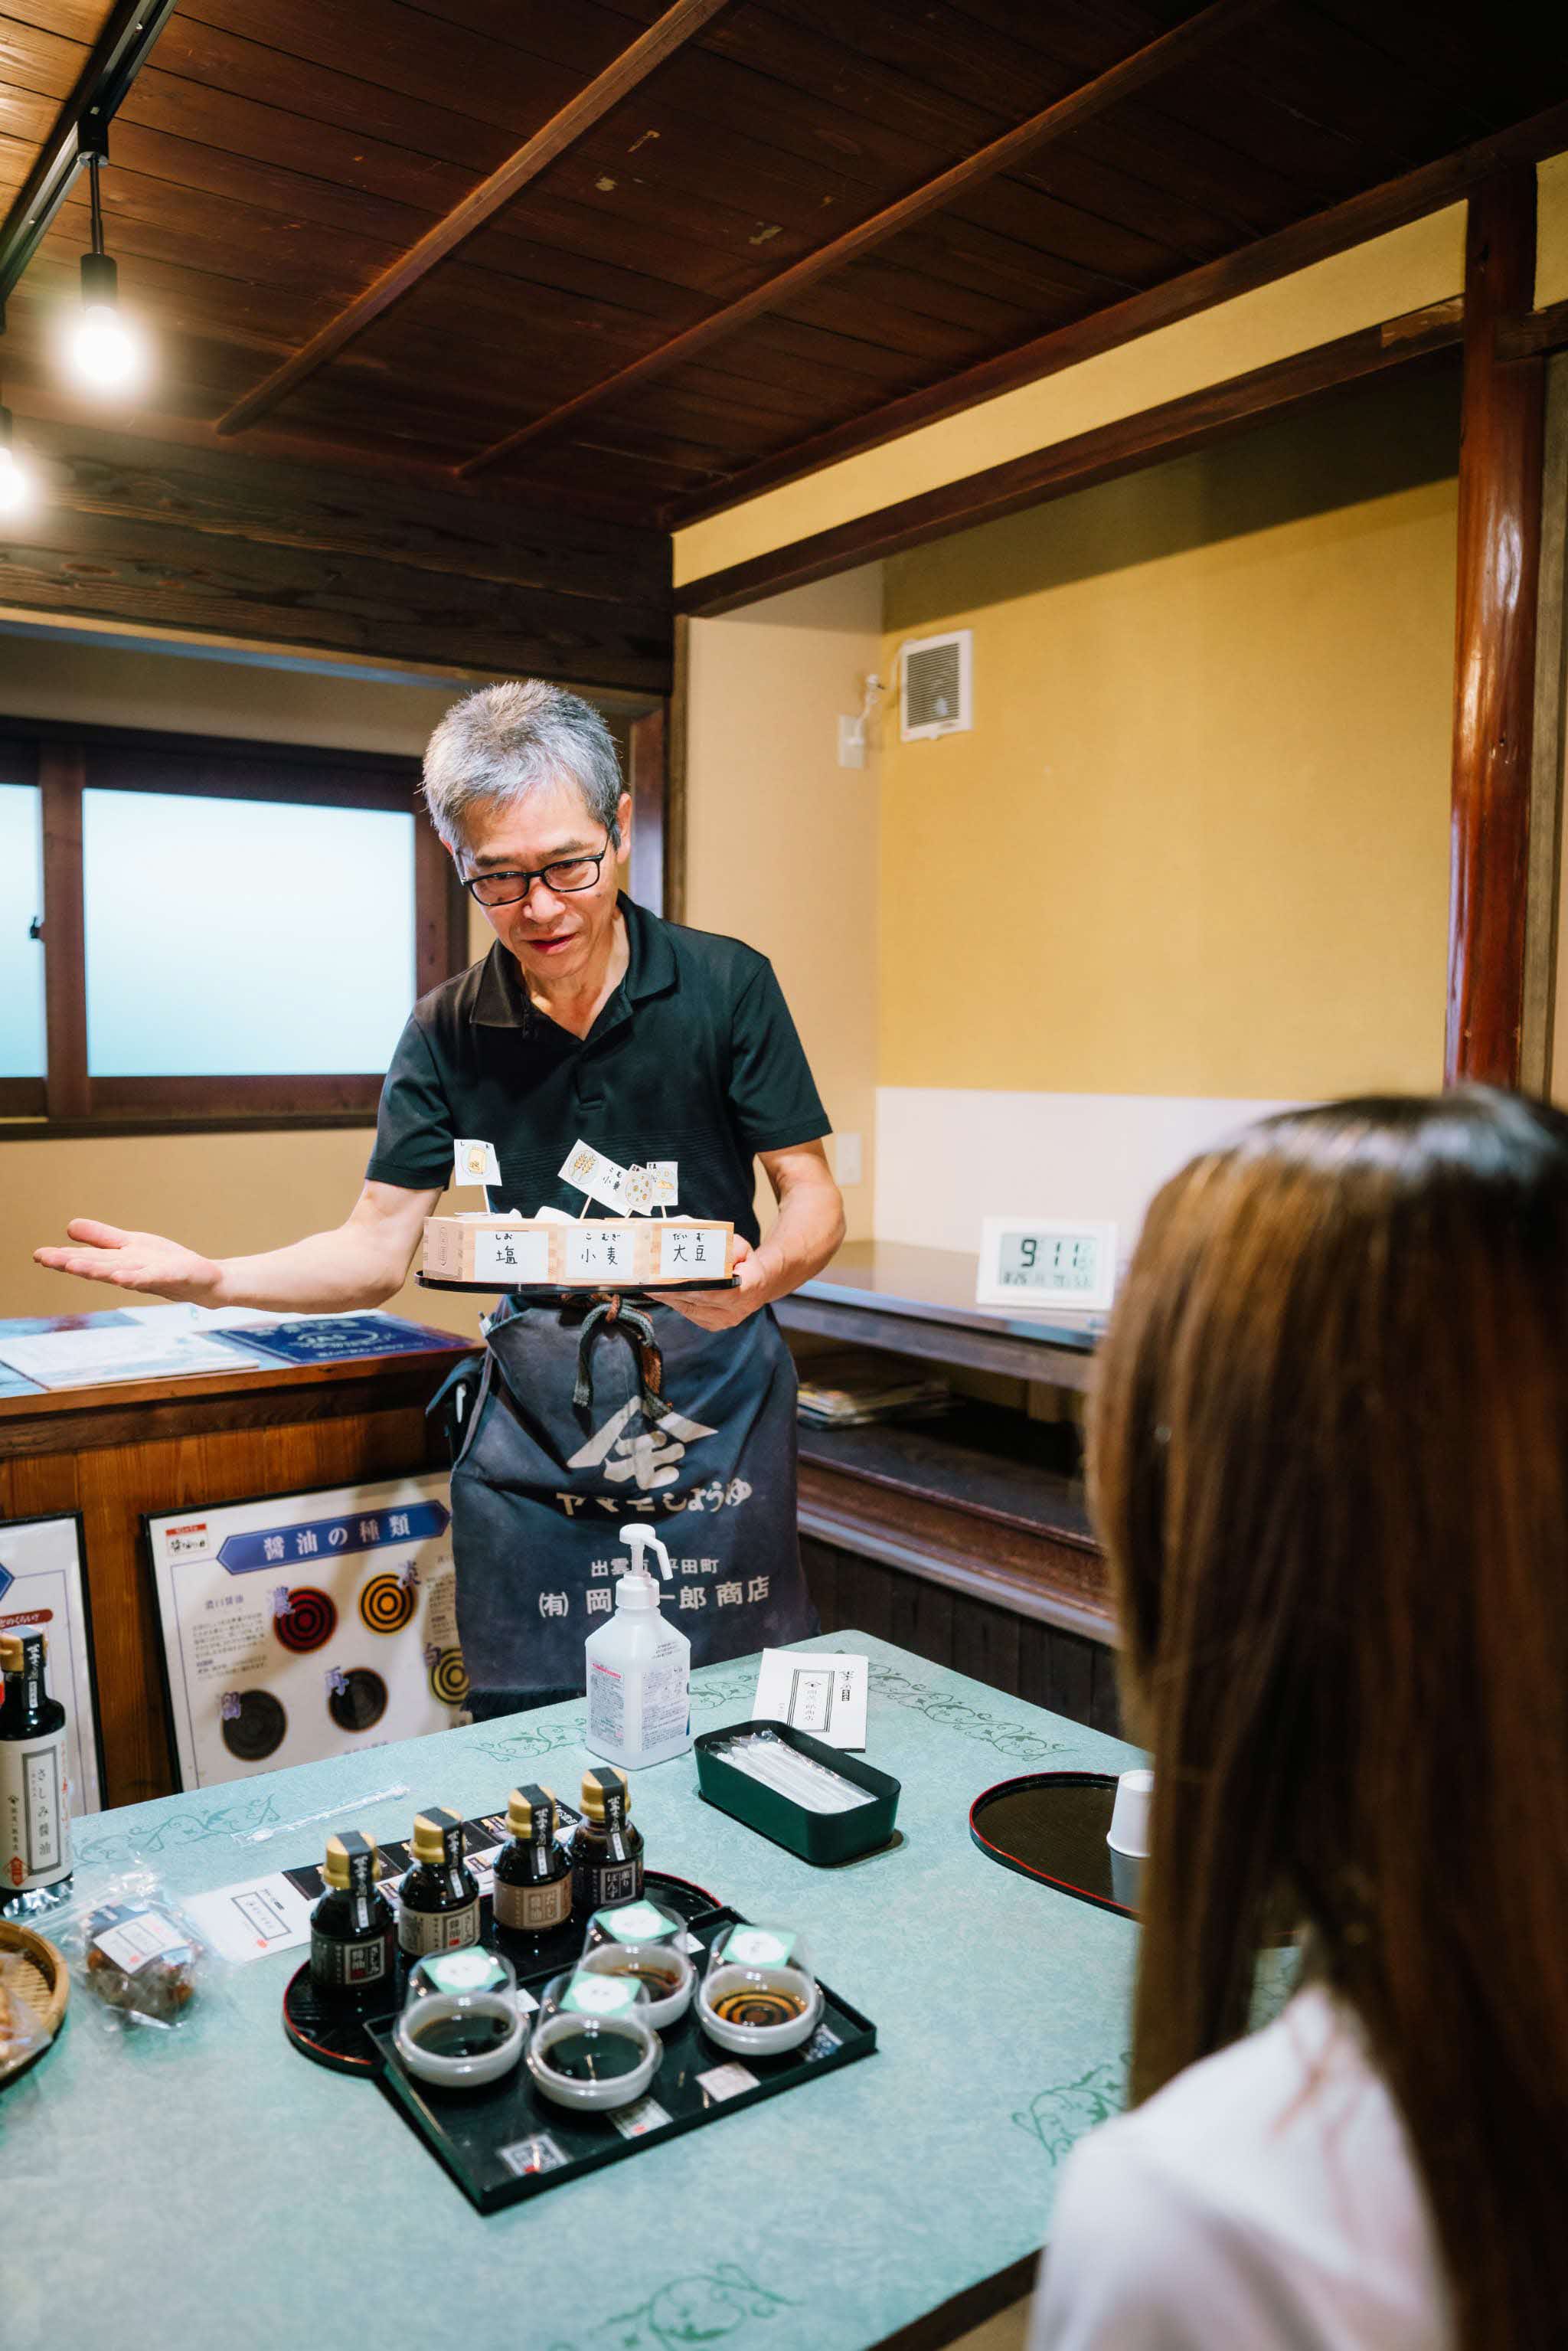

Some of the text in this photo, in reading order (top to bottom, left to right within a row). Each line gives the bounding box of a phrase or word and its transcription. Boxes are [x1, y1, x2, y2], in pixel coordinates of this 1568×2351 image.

[495, 1245, 518, 1264] 塩
[581, 1247, 619, 1265] 小麦
[673, 1244, 707, 1263] 大豆
[263, 1513, 411, 1561] 醤油の種類
[38, 1767, 51, 1856] さしみ醤油
